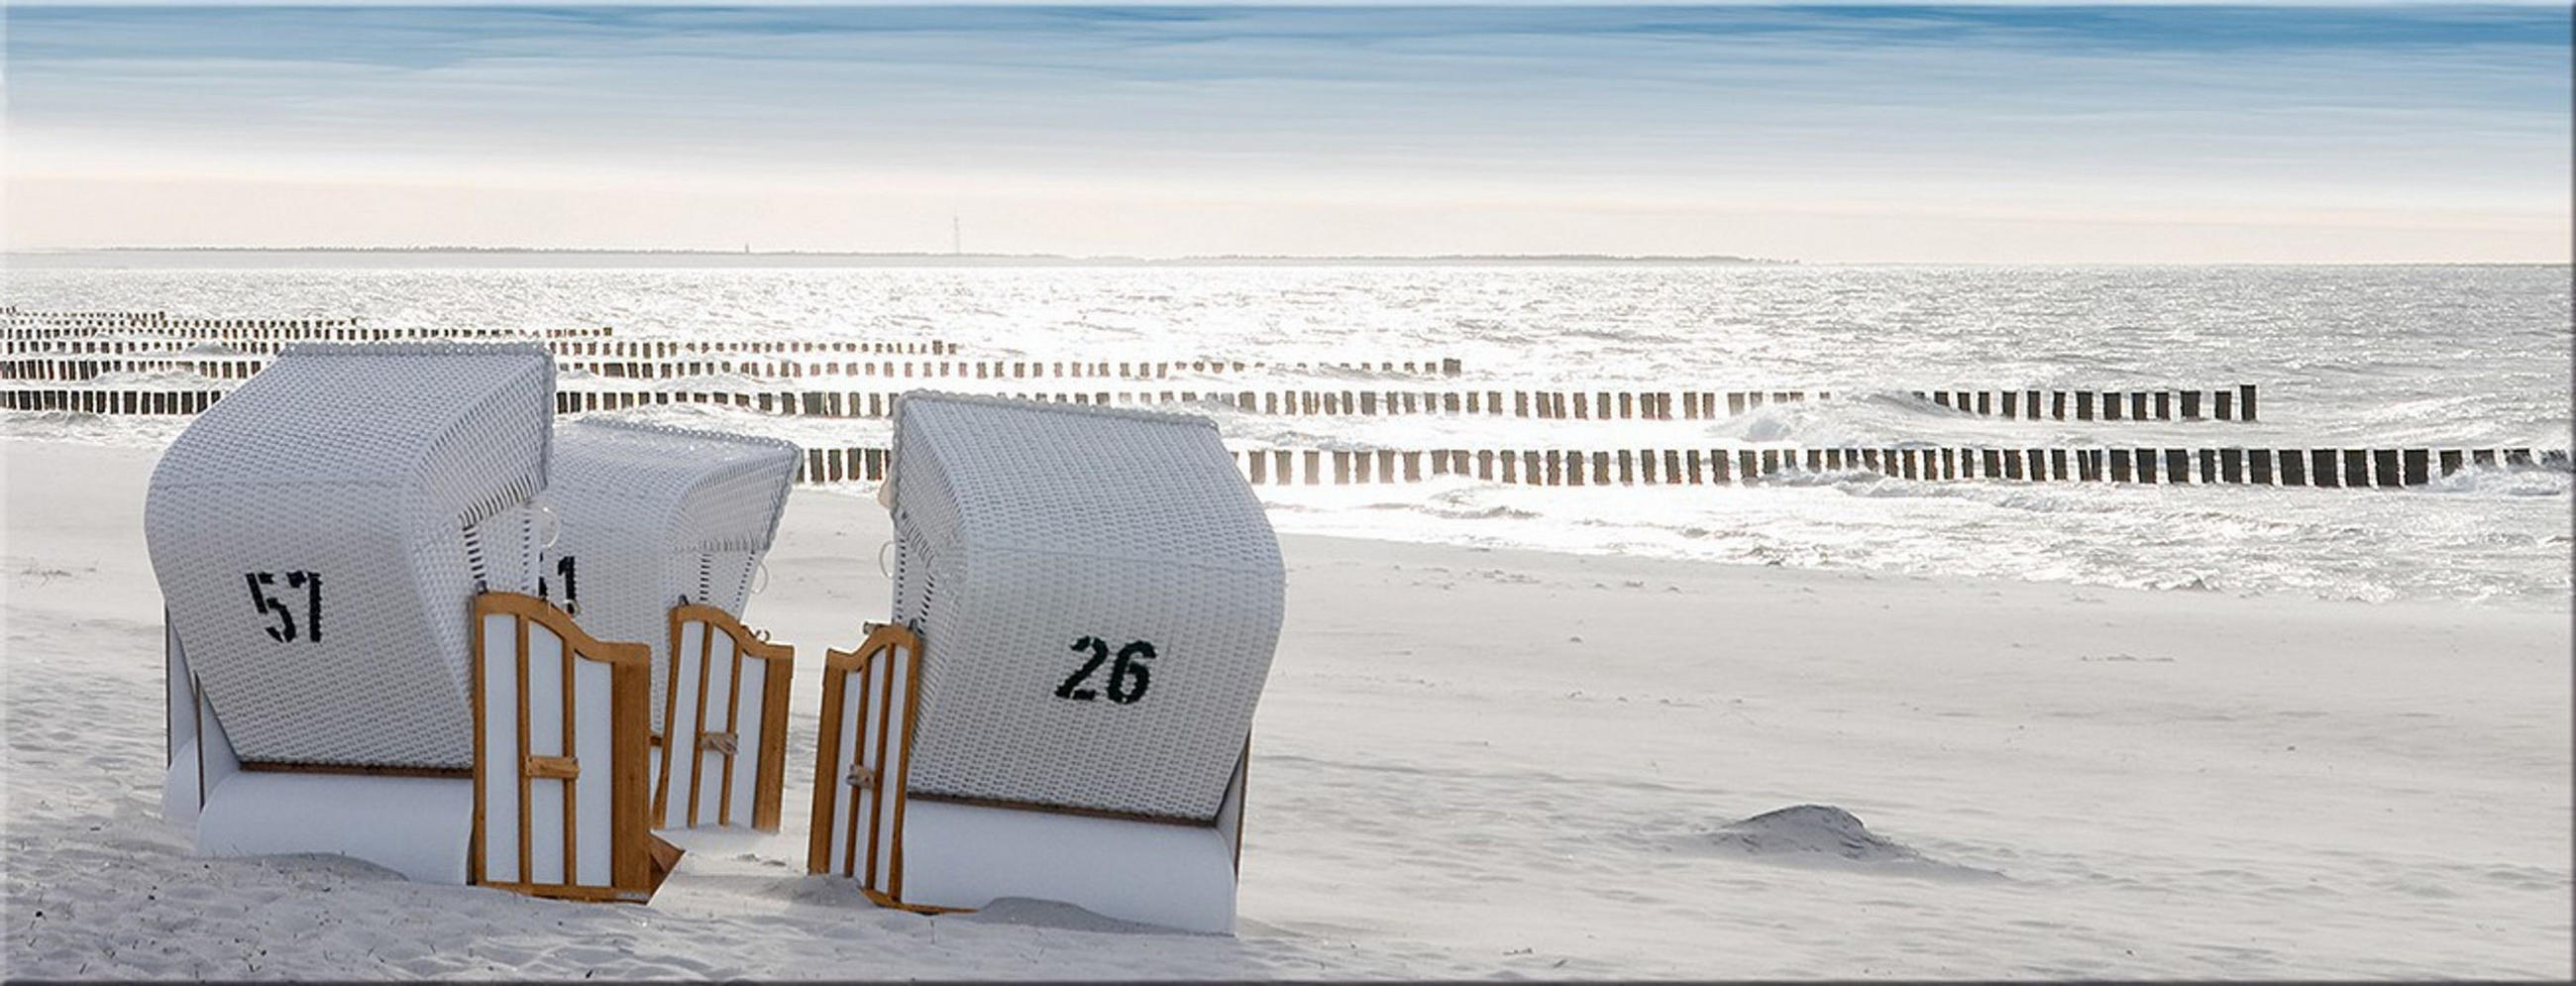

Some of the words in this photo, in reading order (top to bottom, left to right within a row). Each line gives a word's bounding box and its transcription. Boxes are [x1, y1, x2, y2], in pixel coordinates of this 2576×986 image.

[245, 570, 322, 643] 57
[538, 551, 577, 614] 1
[1054, 635, 1157, 705] 26
